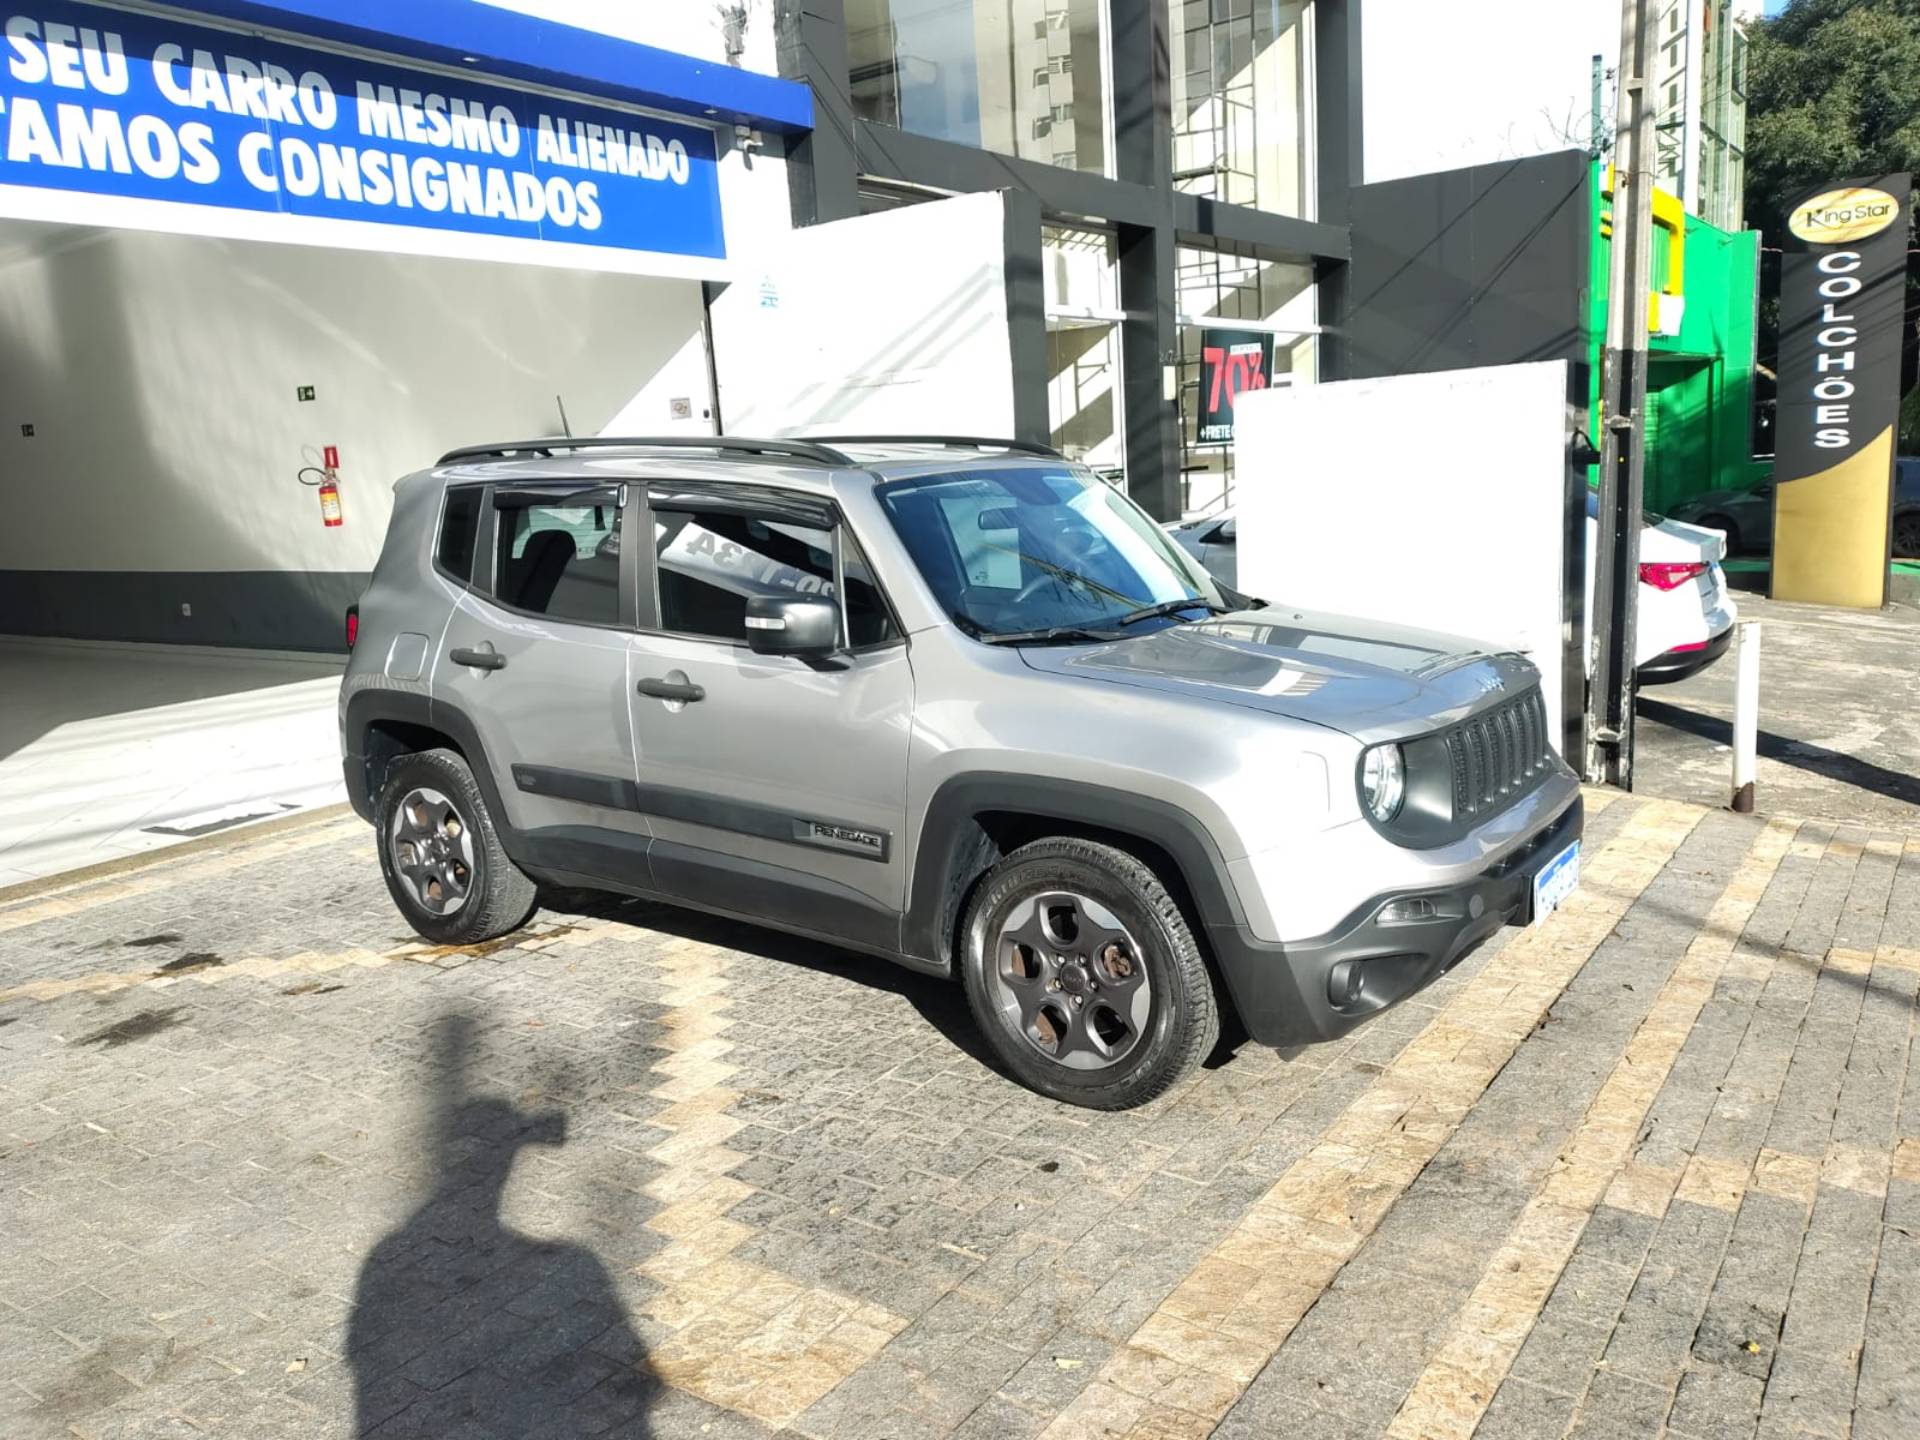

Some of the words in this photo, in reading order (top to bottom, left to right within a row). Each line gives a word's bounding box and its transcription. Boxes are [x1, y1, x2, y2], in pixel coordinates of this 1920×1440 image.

[5, 15, 129, 96] SEU
[152, 43, 337, 131] CARRO
[356, 80, 520, 158] MESMO
[537, 114, 690, 186] ALIENADO
[0, 95, 221, 185] AMOS
[238, 131, 602, 231] CONSIGNADOS
[1806, 208, 1851, 229] King
[1855, 204, 1890, 219] Star
[1203, 347, 1266, 412] 70%
[1814, 251, 1862, 448] COLCHÕES
[815, 825, 881, 848] RENEGADE
